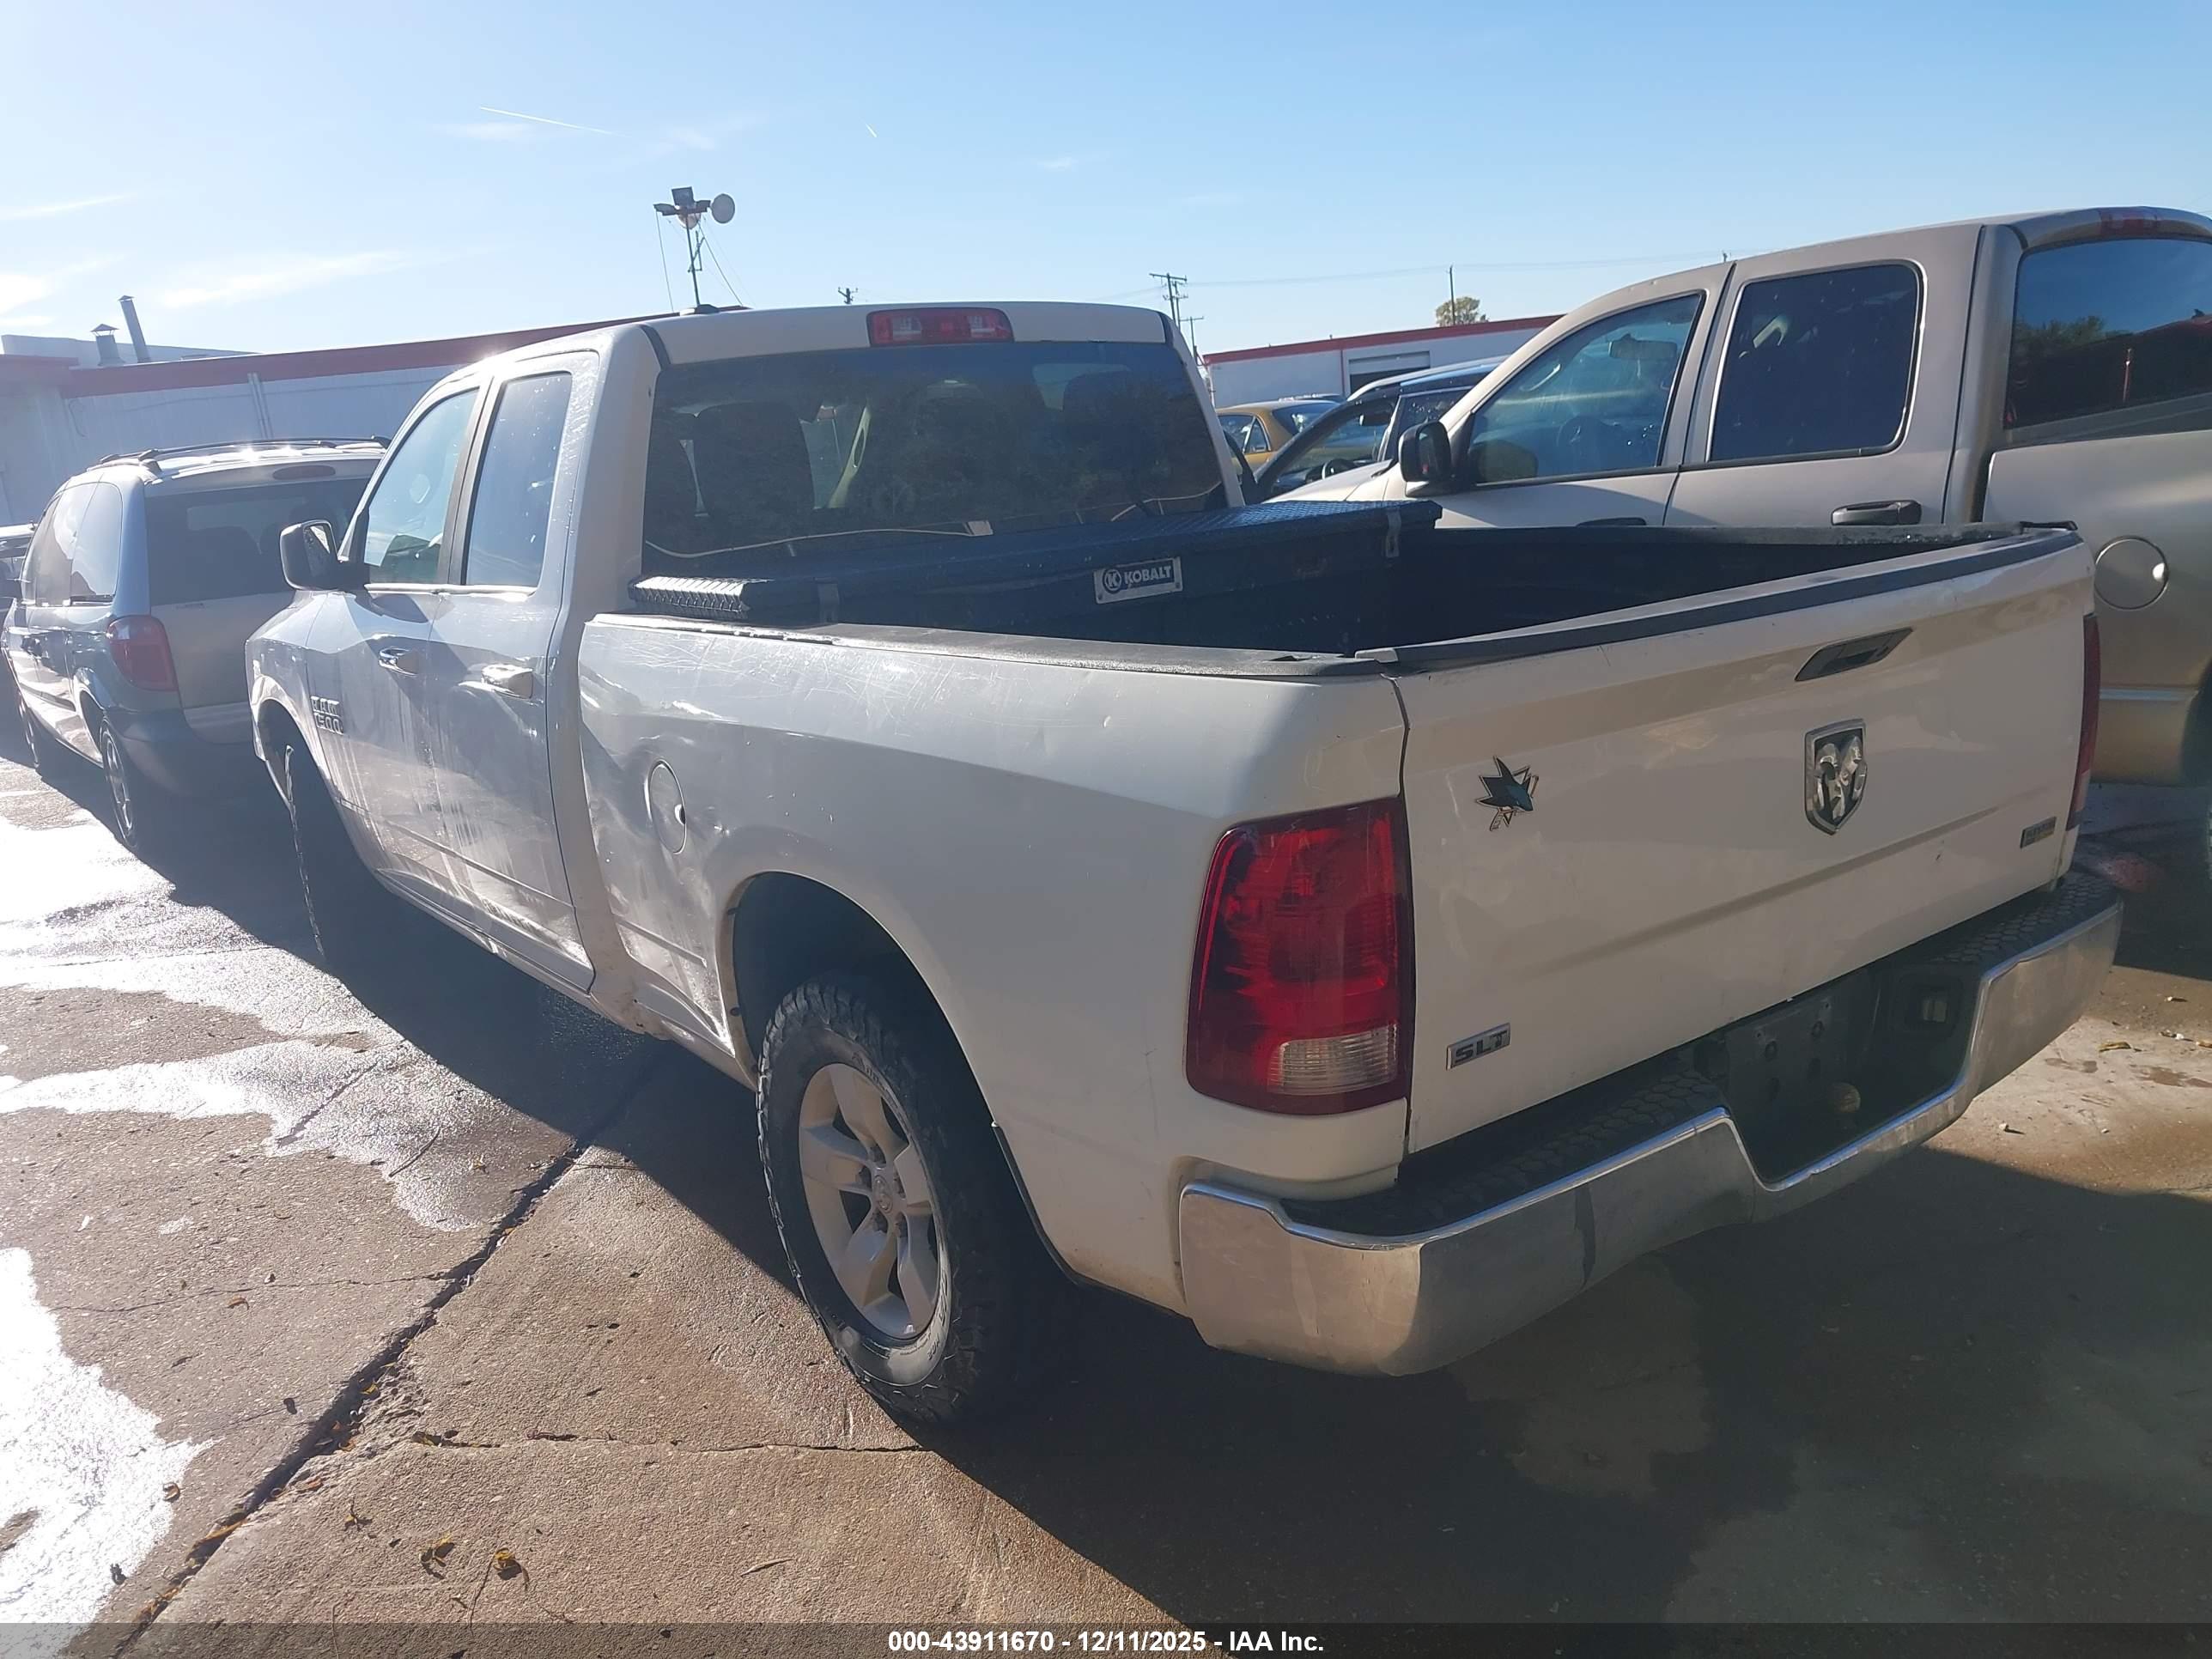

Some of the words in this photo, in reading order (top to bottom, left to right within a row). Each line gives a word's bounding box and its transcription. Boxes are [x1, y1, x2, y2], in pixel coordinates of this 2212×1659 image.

[1123, 566, 1172, 584] KOBALT
[310, 696, 340, 717] RAM
[1455, 1029, 1508, 1065] SLT
